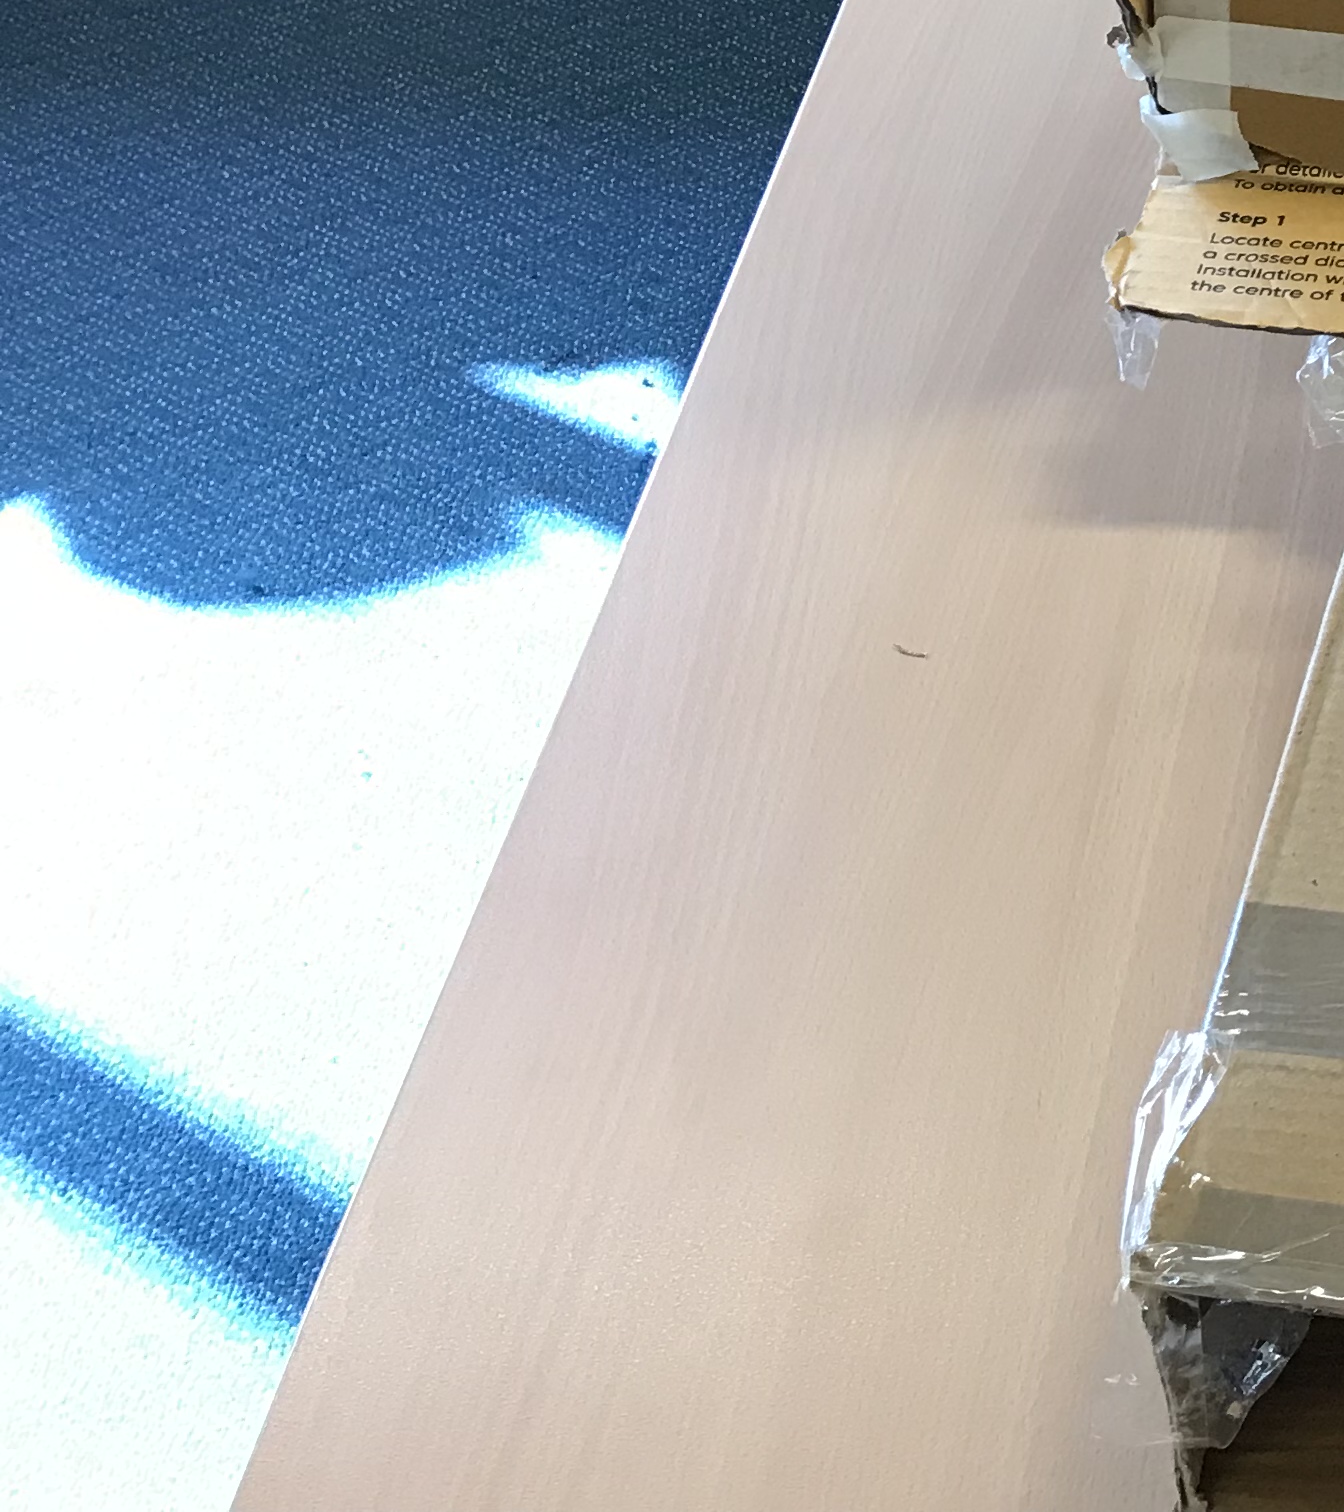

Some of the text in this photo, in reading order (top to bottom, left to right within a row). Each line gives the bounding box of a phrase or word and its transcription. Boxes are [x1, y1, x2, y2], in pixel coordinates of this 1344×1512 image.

[1234, 177, 1255, 190] To
[1261, 179, 1326, 197] obtain
[1331, 185, 1344, 196] a
[1217, 211, 1286, 227] Step 1
[1209, 232, 1283, 250] Locate
[1202, 249, 1218, 260] a
[1224, 249, 1310, 266] crossed
[1196, 263, 1319, 283] Installation
[1190, 279, 1226, 294] the
[1232, 284, 1304, 300] centre
[1309, 288, 1334, 302] of
